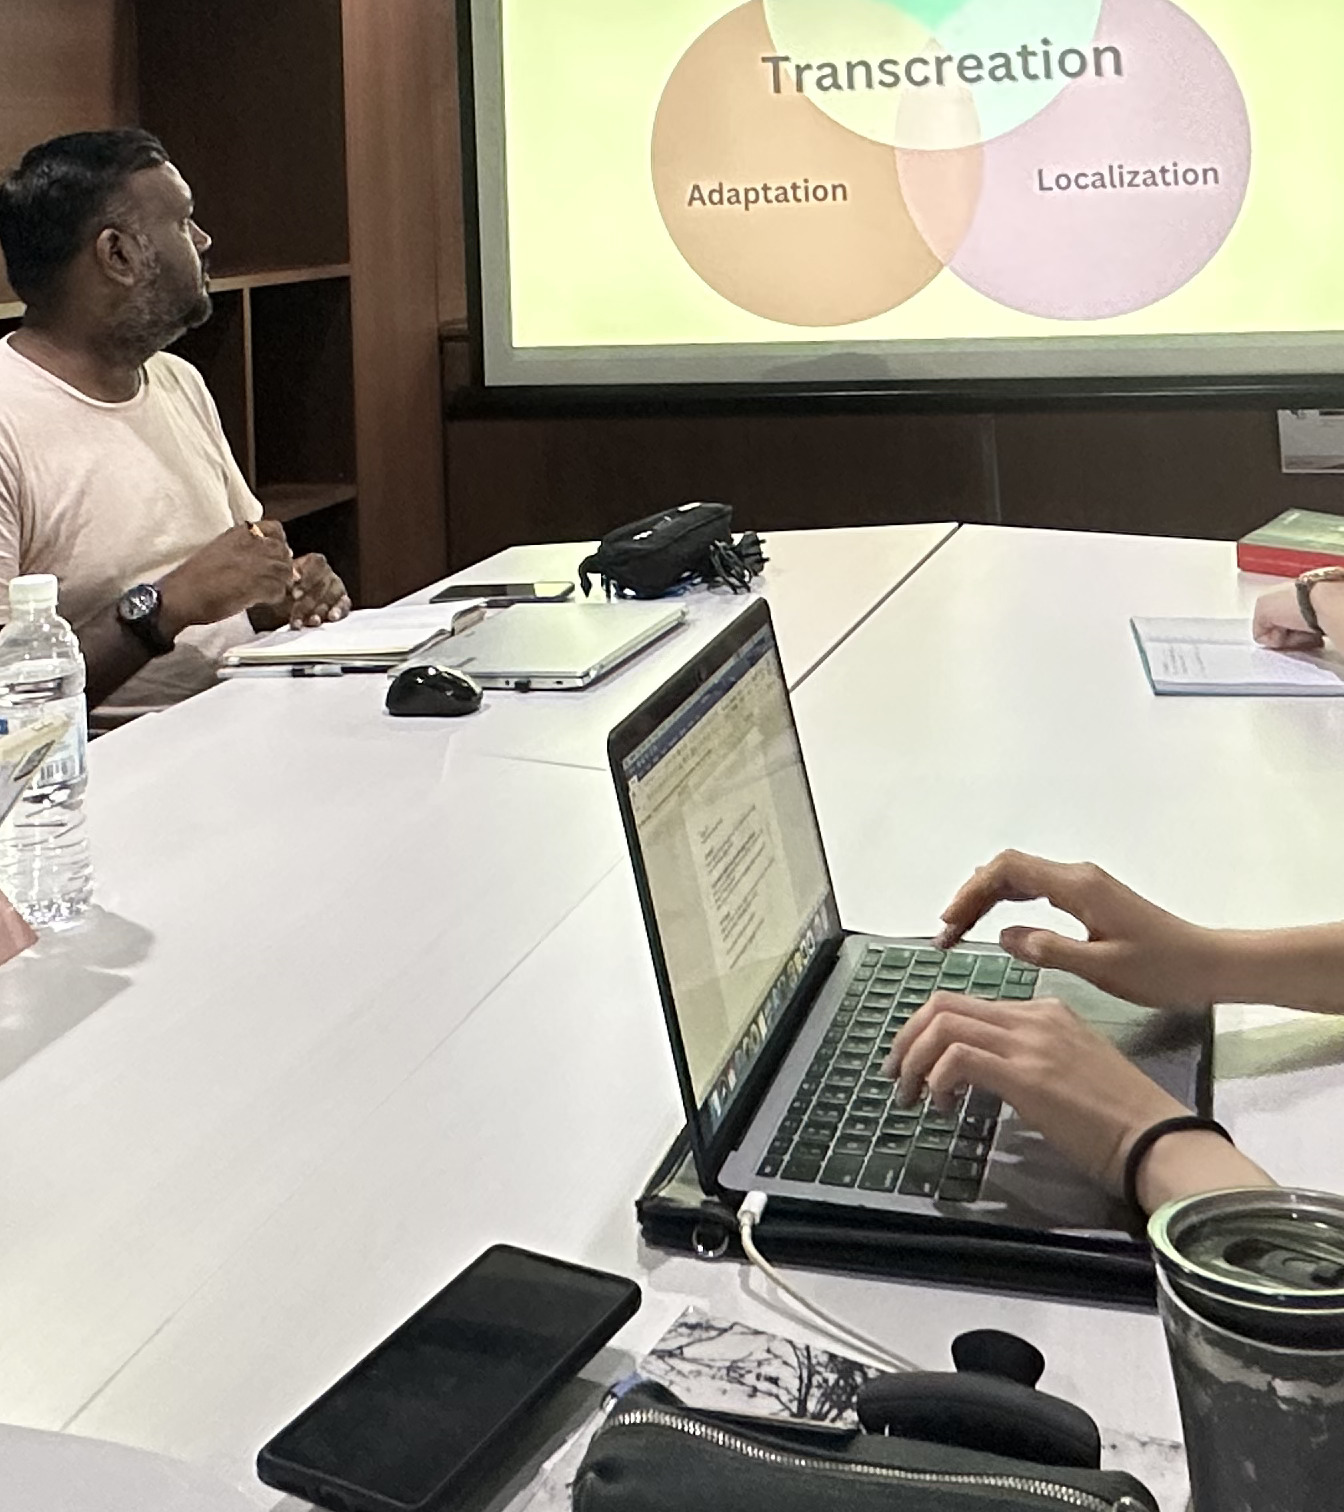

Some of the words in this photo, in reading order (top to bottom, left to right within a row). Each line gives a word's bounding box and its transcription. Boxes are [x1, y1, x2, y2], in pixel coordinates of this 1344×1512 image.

[761, 36, 1125, 96] Transcreation
[687, 174, 849, 211] Adaptation
[1036, 158, 1221, 193] Localization
